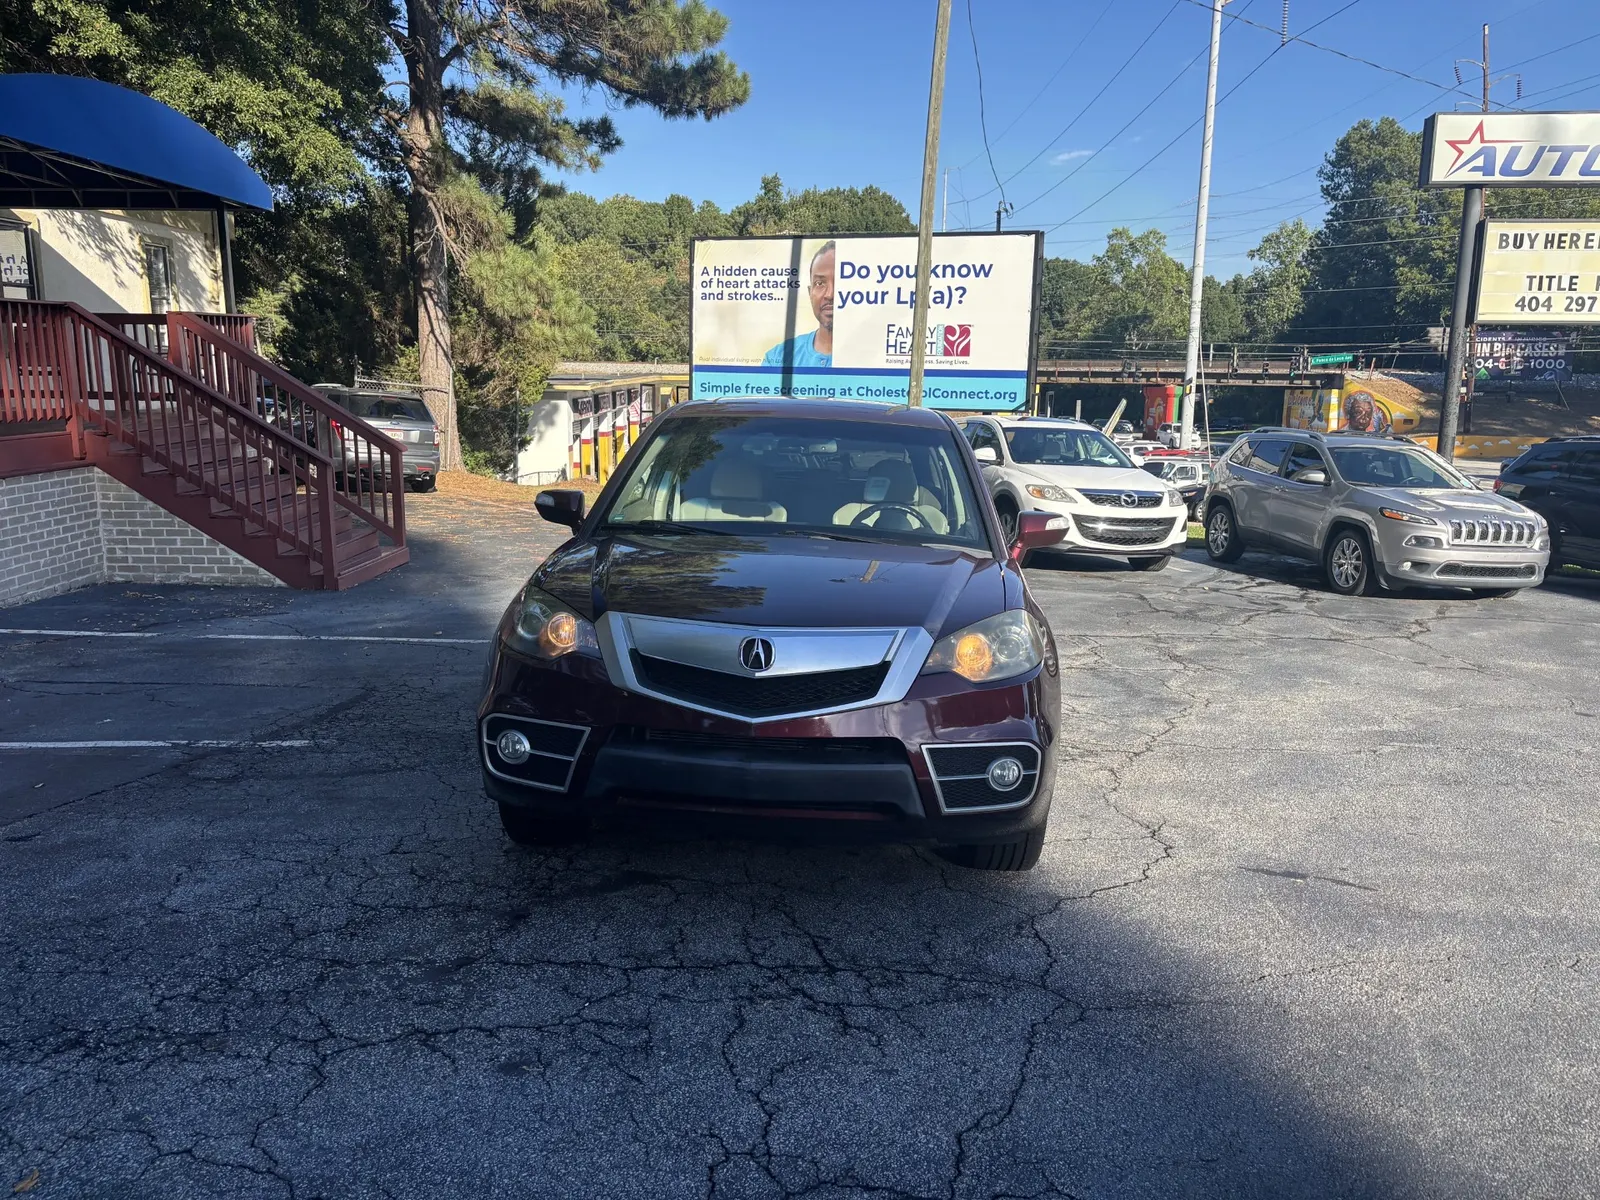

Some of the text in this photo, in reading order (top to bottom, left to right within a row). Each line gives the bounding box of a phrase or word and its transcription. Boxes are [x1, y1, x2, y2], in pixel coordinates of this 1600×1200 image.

[1498, 233, 1596, 250] BUY HERE
[701, 265, 798, 276] A hidden cause
[840, 261, 994, 284] Do you know
[701, 278, 800, 289] of heart attacks
[1526, 275, 1579, 292] TITLE
[701, 290, 784, 301] and strokes...
[837, 289, 889, 309] your
[1514, 295, 1598, 312] 404 297
[887, 324, 936, 339] FAMY
[886, 339, 936, 354] HET
[700, 382, 1018, 403] Simple free screening at CholestolConnect.org
